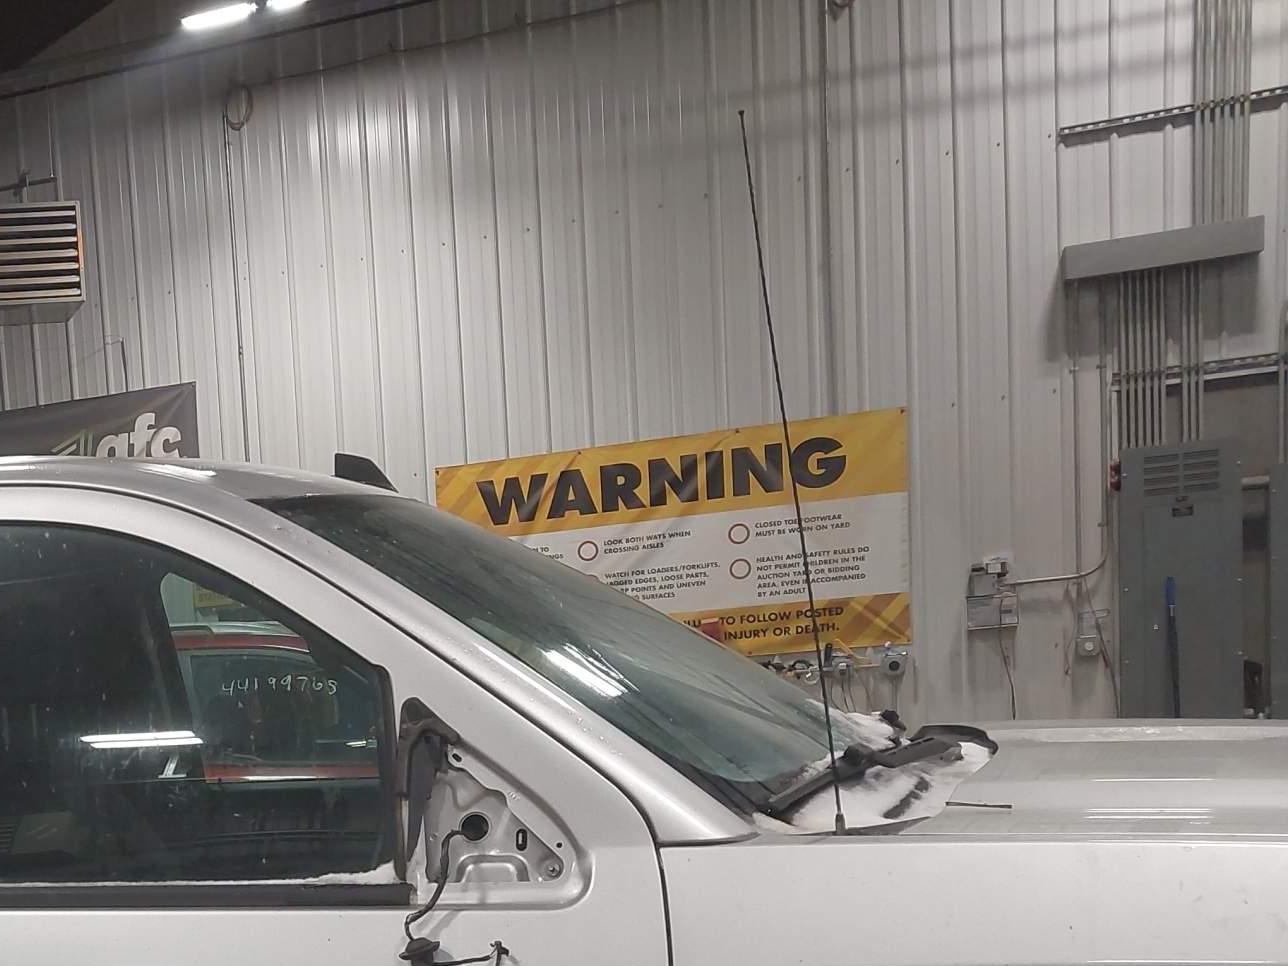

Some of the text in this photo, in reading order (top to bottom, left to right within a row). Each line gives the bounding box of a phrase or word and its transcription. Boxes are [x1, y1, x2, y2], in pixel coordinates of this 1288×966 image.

[477, 436, 847, 526] WARNING
[755, 520, 782, 528] CLOSED
[801, 514, 842, 523] OOTWEAR
[625, 536, 645, 544] BOTH
[646, 533, 667, 541] WAYS
[668, 530, 691, 538] WHEN
[604, 542, 664, 554] CROSSING AISLES
[827, 565, 860, 573] BIDDING
[677, 580, 706, 588] UNEVEN
[811, 573, 866, 583] ACCOMPANIED
[642, 592, 675, 600] SURFACES
[719, 606, 844, 625] TO FOLLOW POSTED
[724, 628, 768, 640] INJURY
[773, 626, 791, 636] OR
